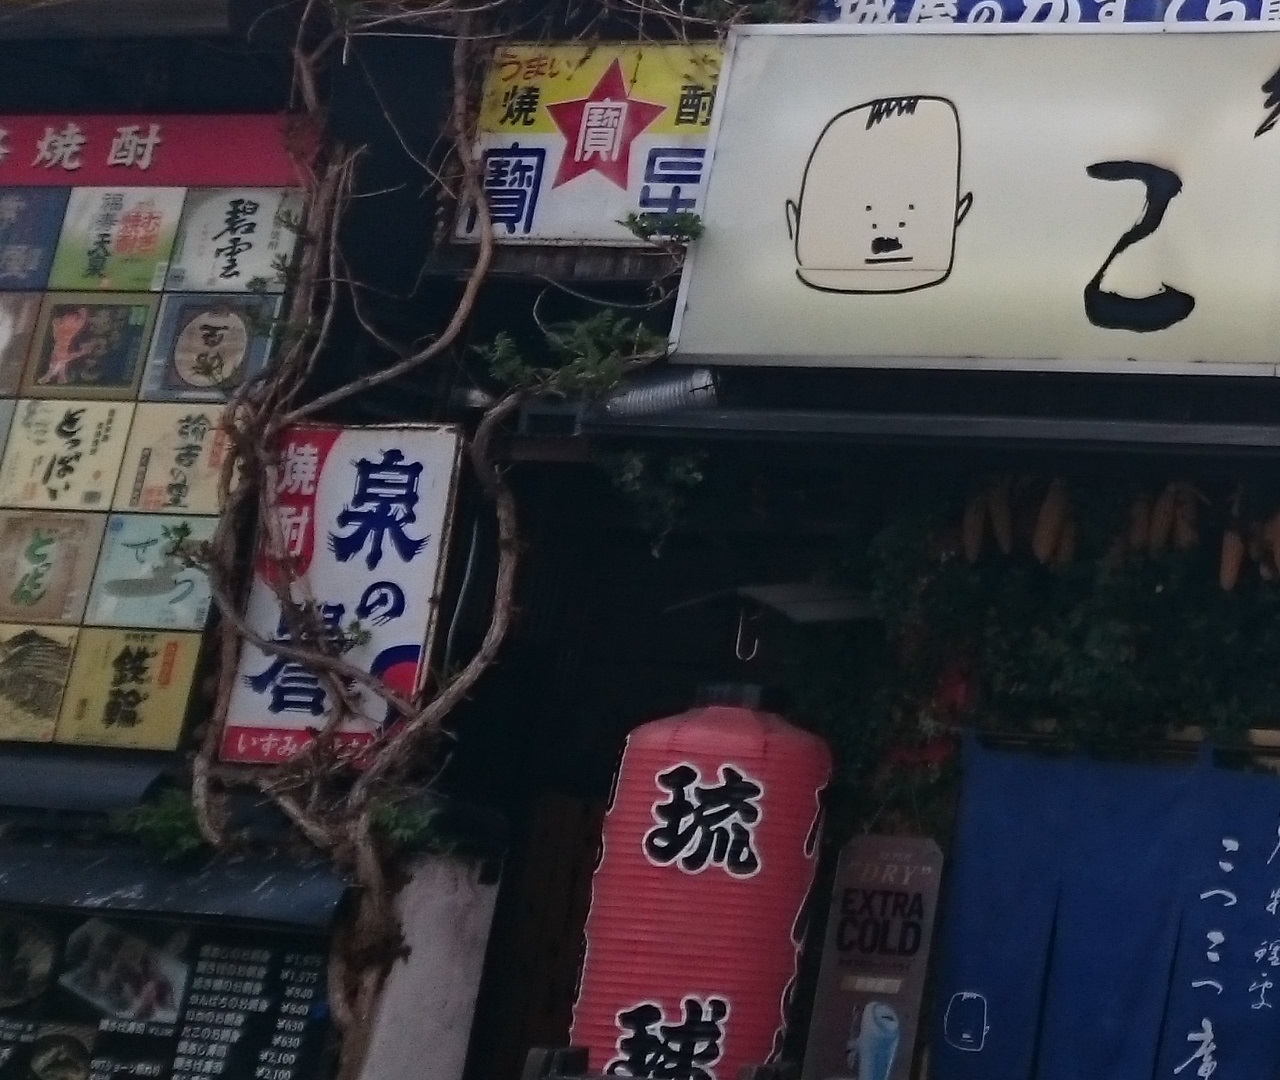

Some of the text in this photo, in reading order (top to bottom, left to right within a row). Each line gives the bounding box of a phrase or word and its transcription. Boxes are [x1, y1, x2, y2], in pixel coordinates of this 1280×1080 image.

[602, 760, 764, 1080] 琉球
[840, 887, 924, 920] EXTRA
[835, 918, 923, 958] COLD
